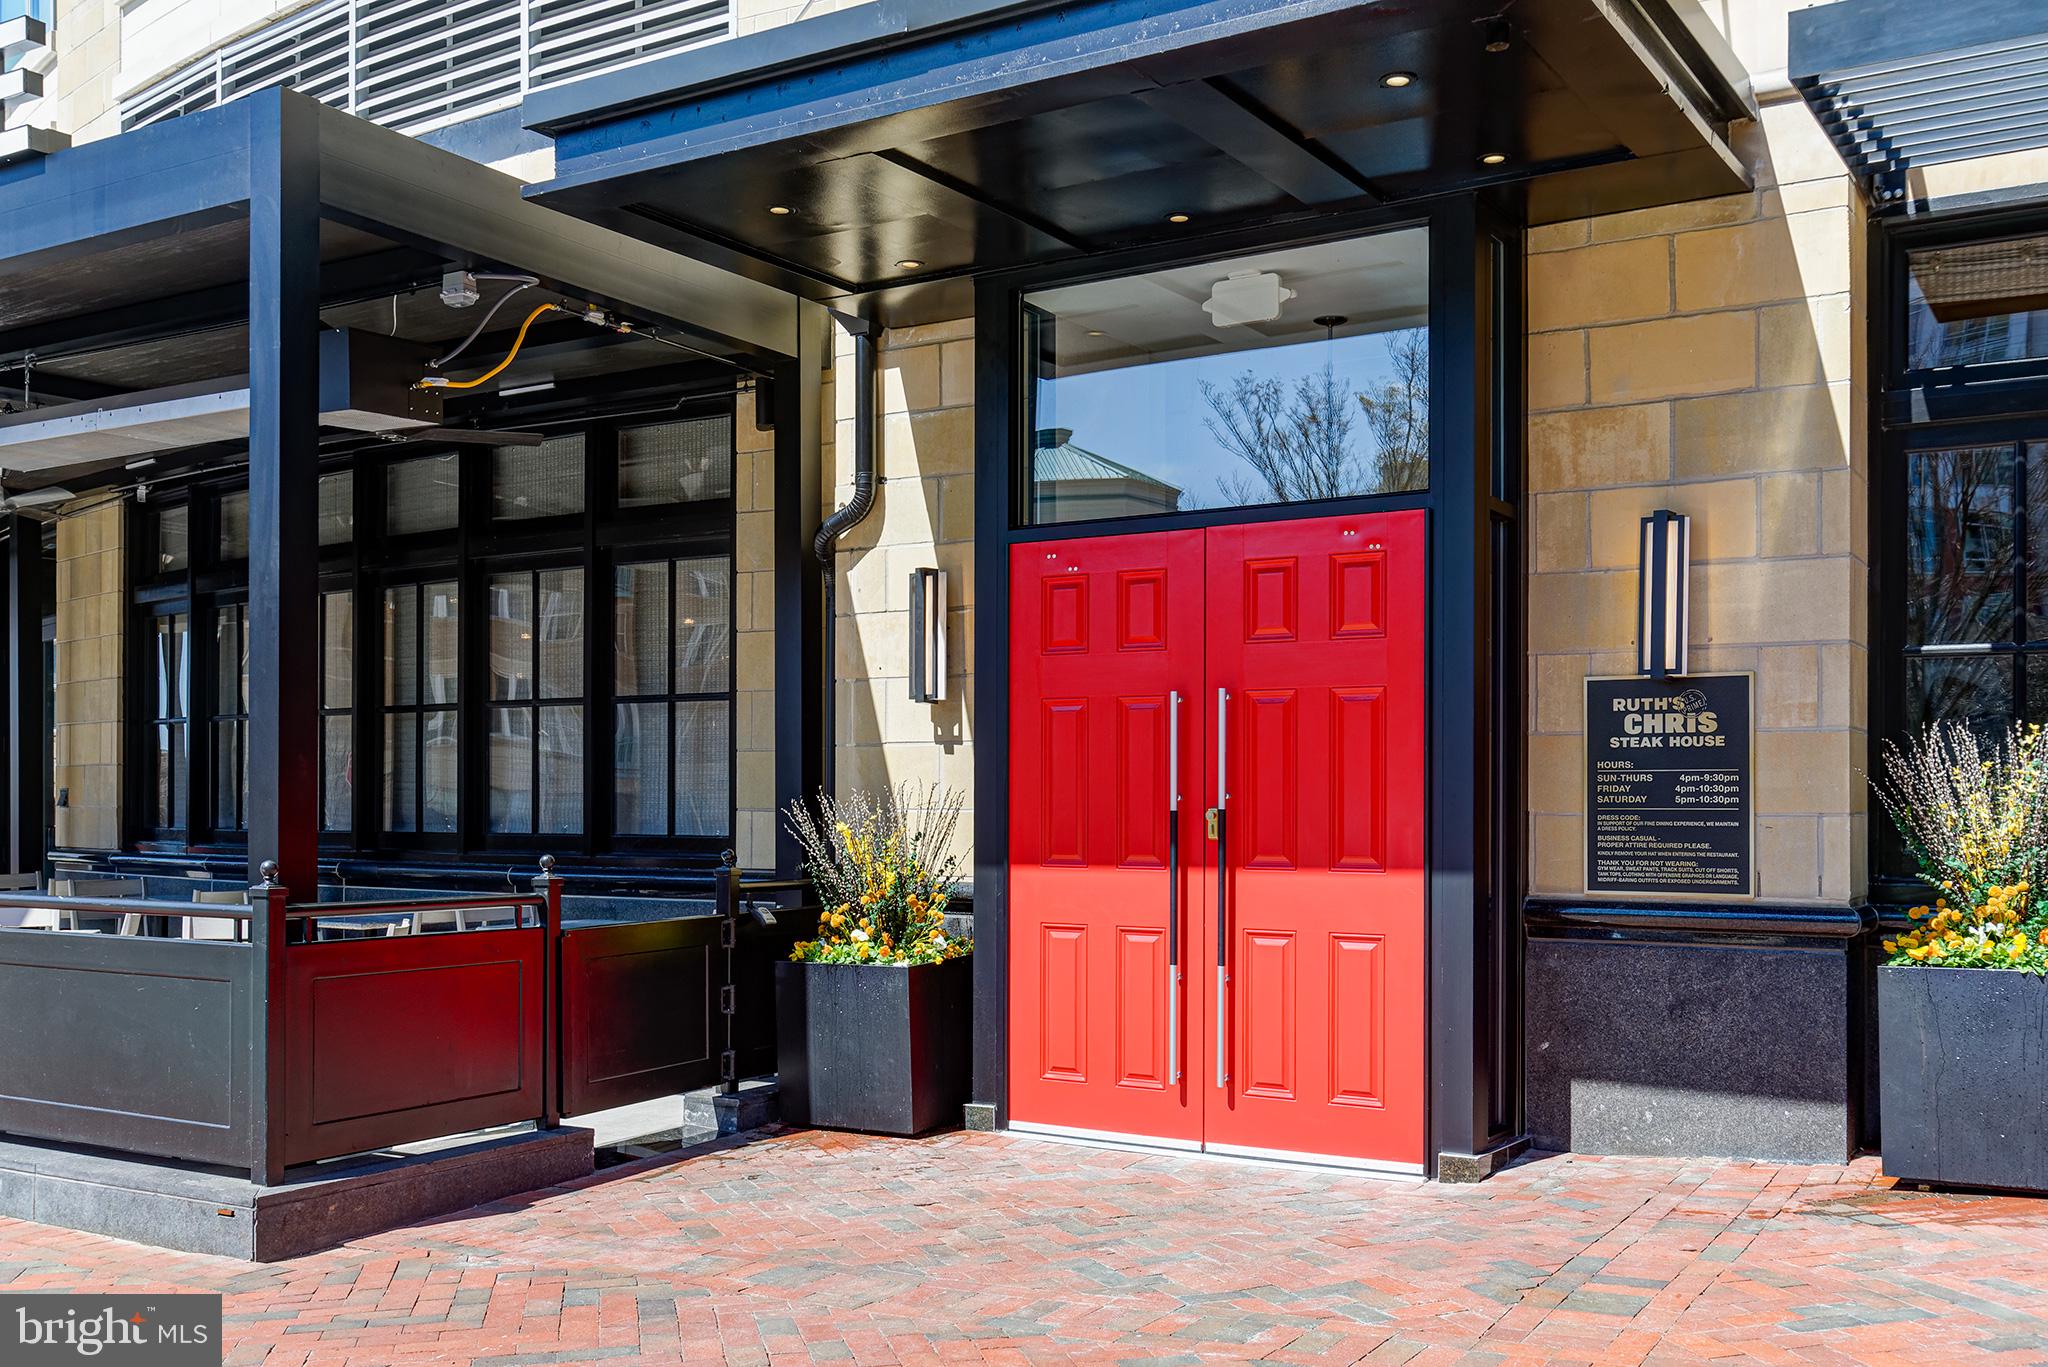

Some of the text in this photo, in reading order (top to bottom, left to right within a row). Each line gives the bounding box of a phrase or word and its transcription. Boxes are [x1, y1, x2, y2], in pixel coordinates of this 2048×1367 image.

[1612, 697, 1685, 712] RUTH'S
[1682, 700, 1704, 714] PRIME
[1623, 711, 1718, 735] CHRIS
[1610, 735, 1725, 748] STEAK HOUSE
[1597, 761, 1634, 769] HOURS:
[1597, 774, 1739, 782] SUN-THURS 4pm-9:30pm
[1597, 785, 1739, 794] FRIDAY 4pm-10:30pm
[1597, 796, 1739, 804] SATURDAY 5pm-10:30pm
